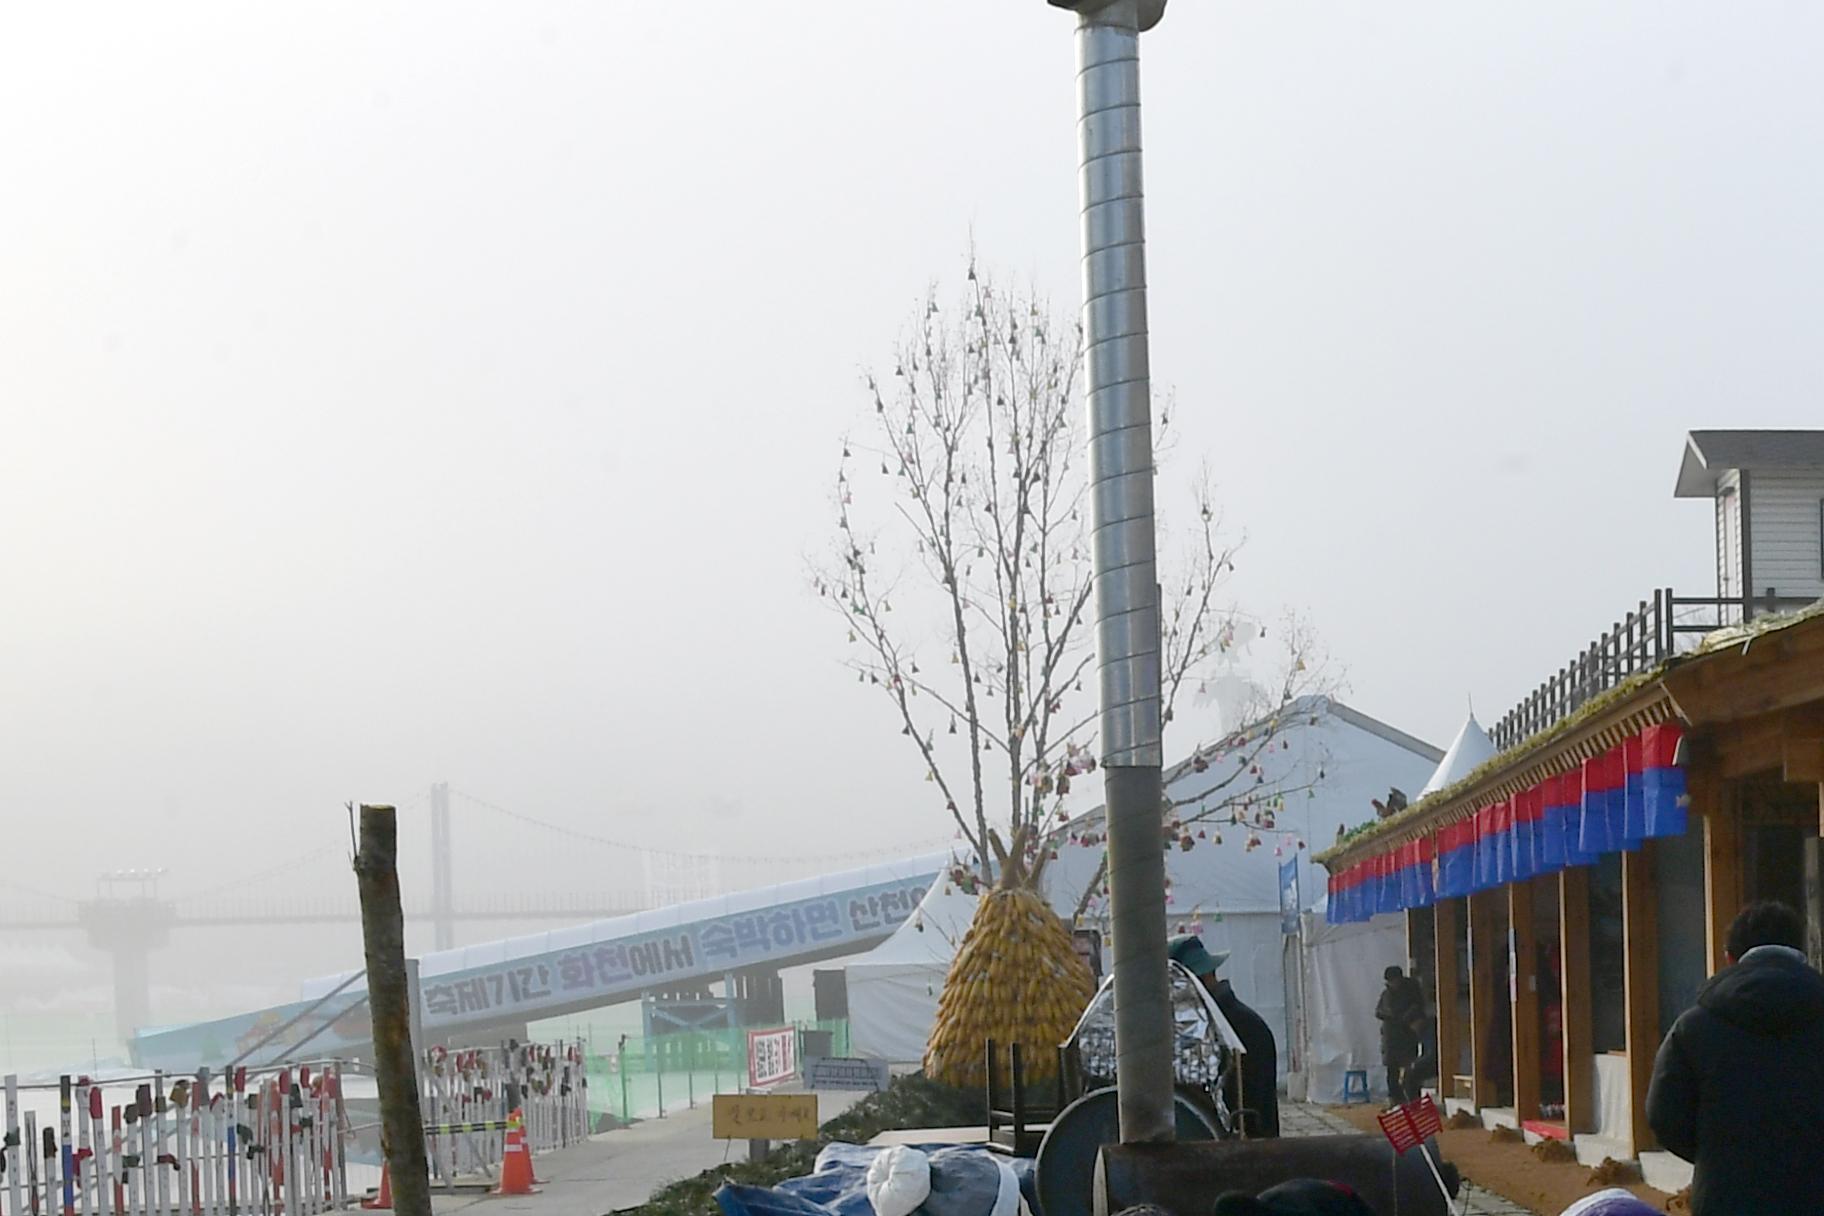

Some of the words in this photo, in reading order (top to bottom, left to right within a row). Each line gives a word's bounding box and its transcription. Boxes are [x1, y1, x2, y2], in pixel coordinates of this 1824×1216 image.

[425, 965, 550, 1017] 축제기간
[558, 935, 694, 992] 화천에서
[700, 901, 843, 959] 숙박하면
[849, 884, 934, 931] 산천
